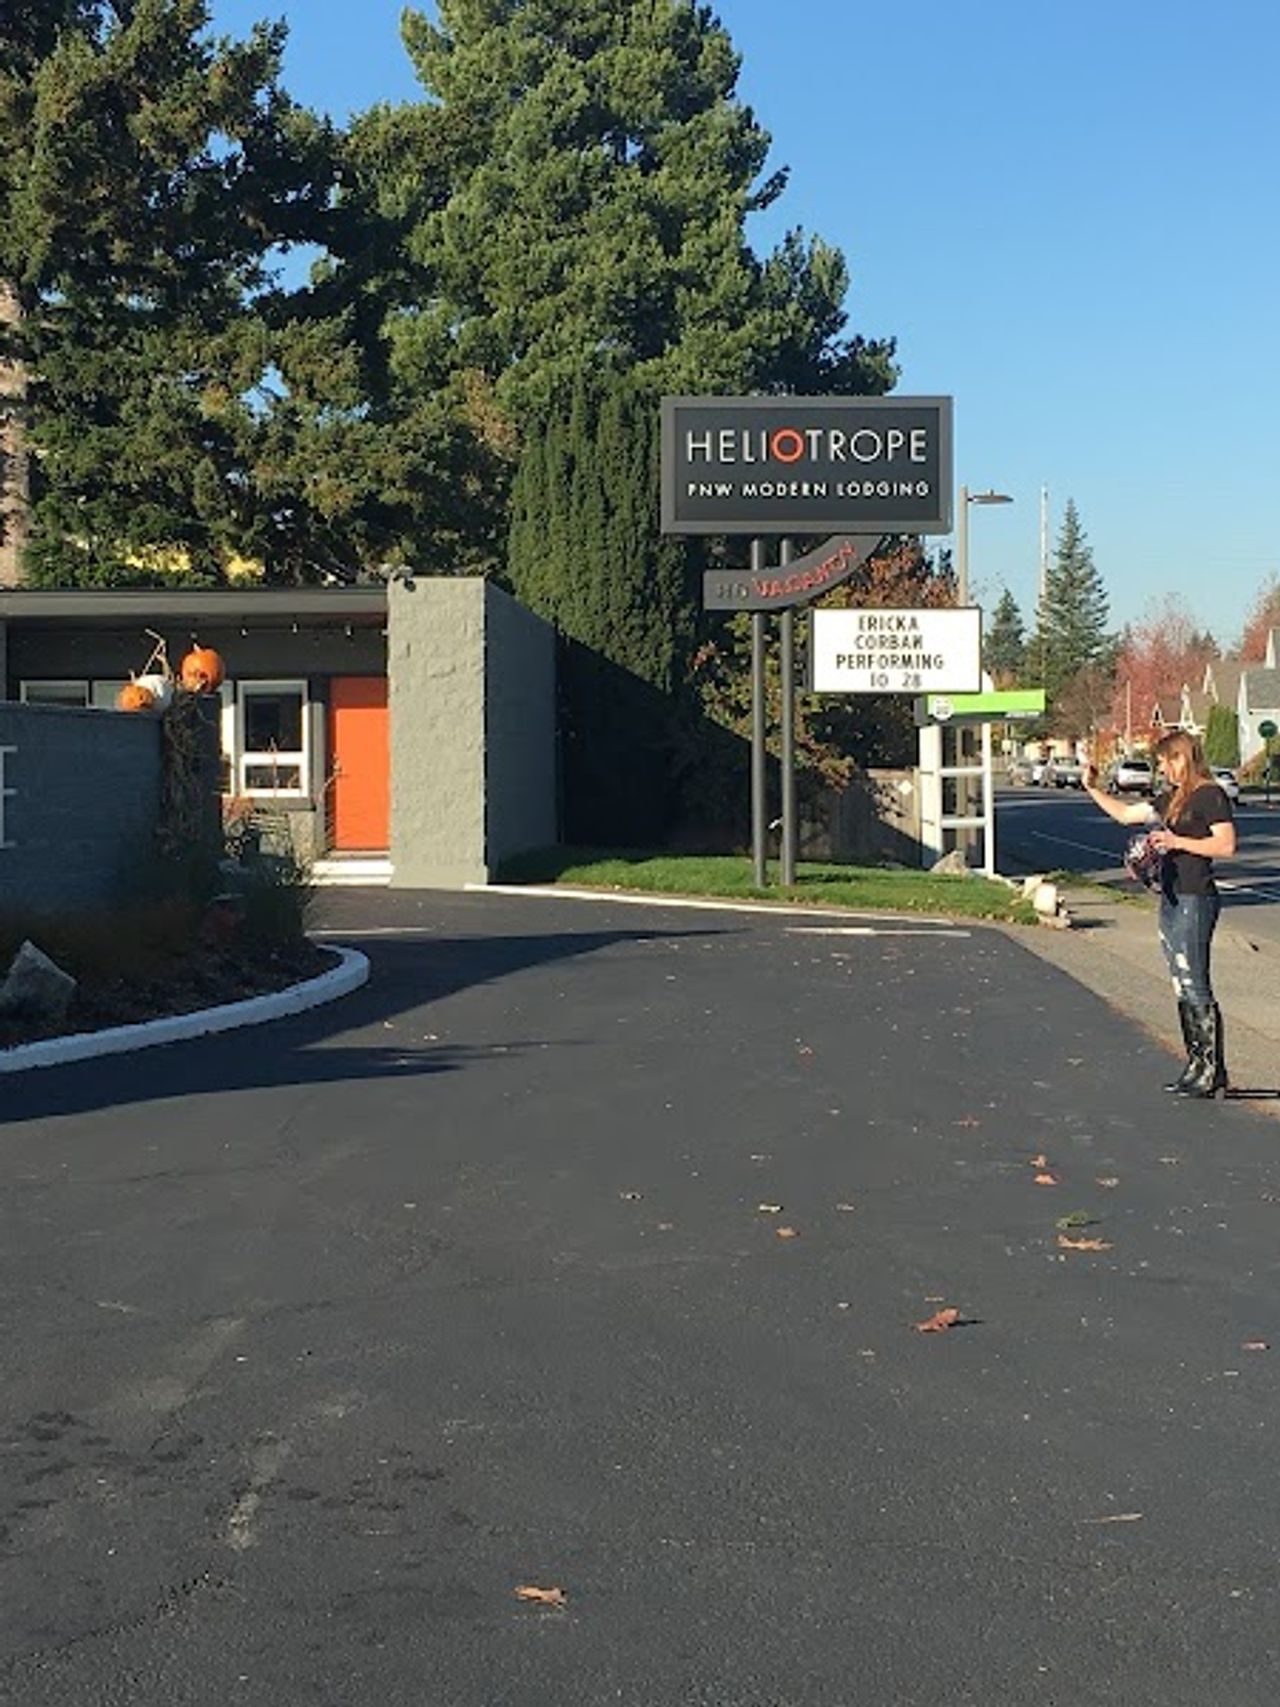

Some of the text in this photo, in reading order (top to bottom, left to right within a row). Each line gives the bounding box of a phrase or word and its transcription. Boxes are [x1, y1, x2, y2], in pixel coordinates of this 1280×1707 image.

[686, 428, 928, 462] HELIOTROPE
[687, 483, 930, 497] PNW MODERN LODGING
[858, 615, 920, 632] ERICKA
[836, 654, 945, 670] PERFORMING
